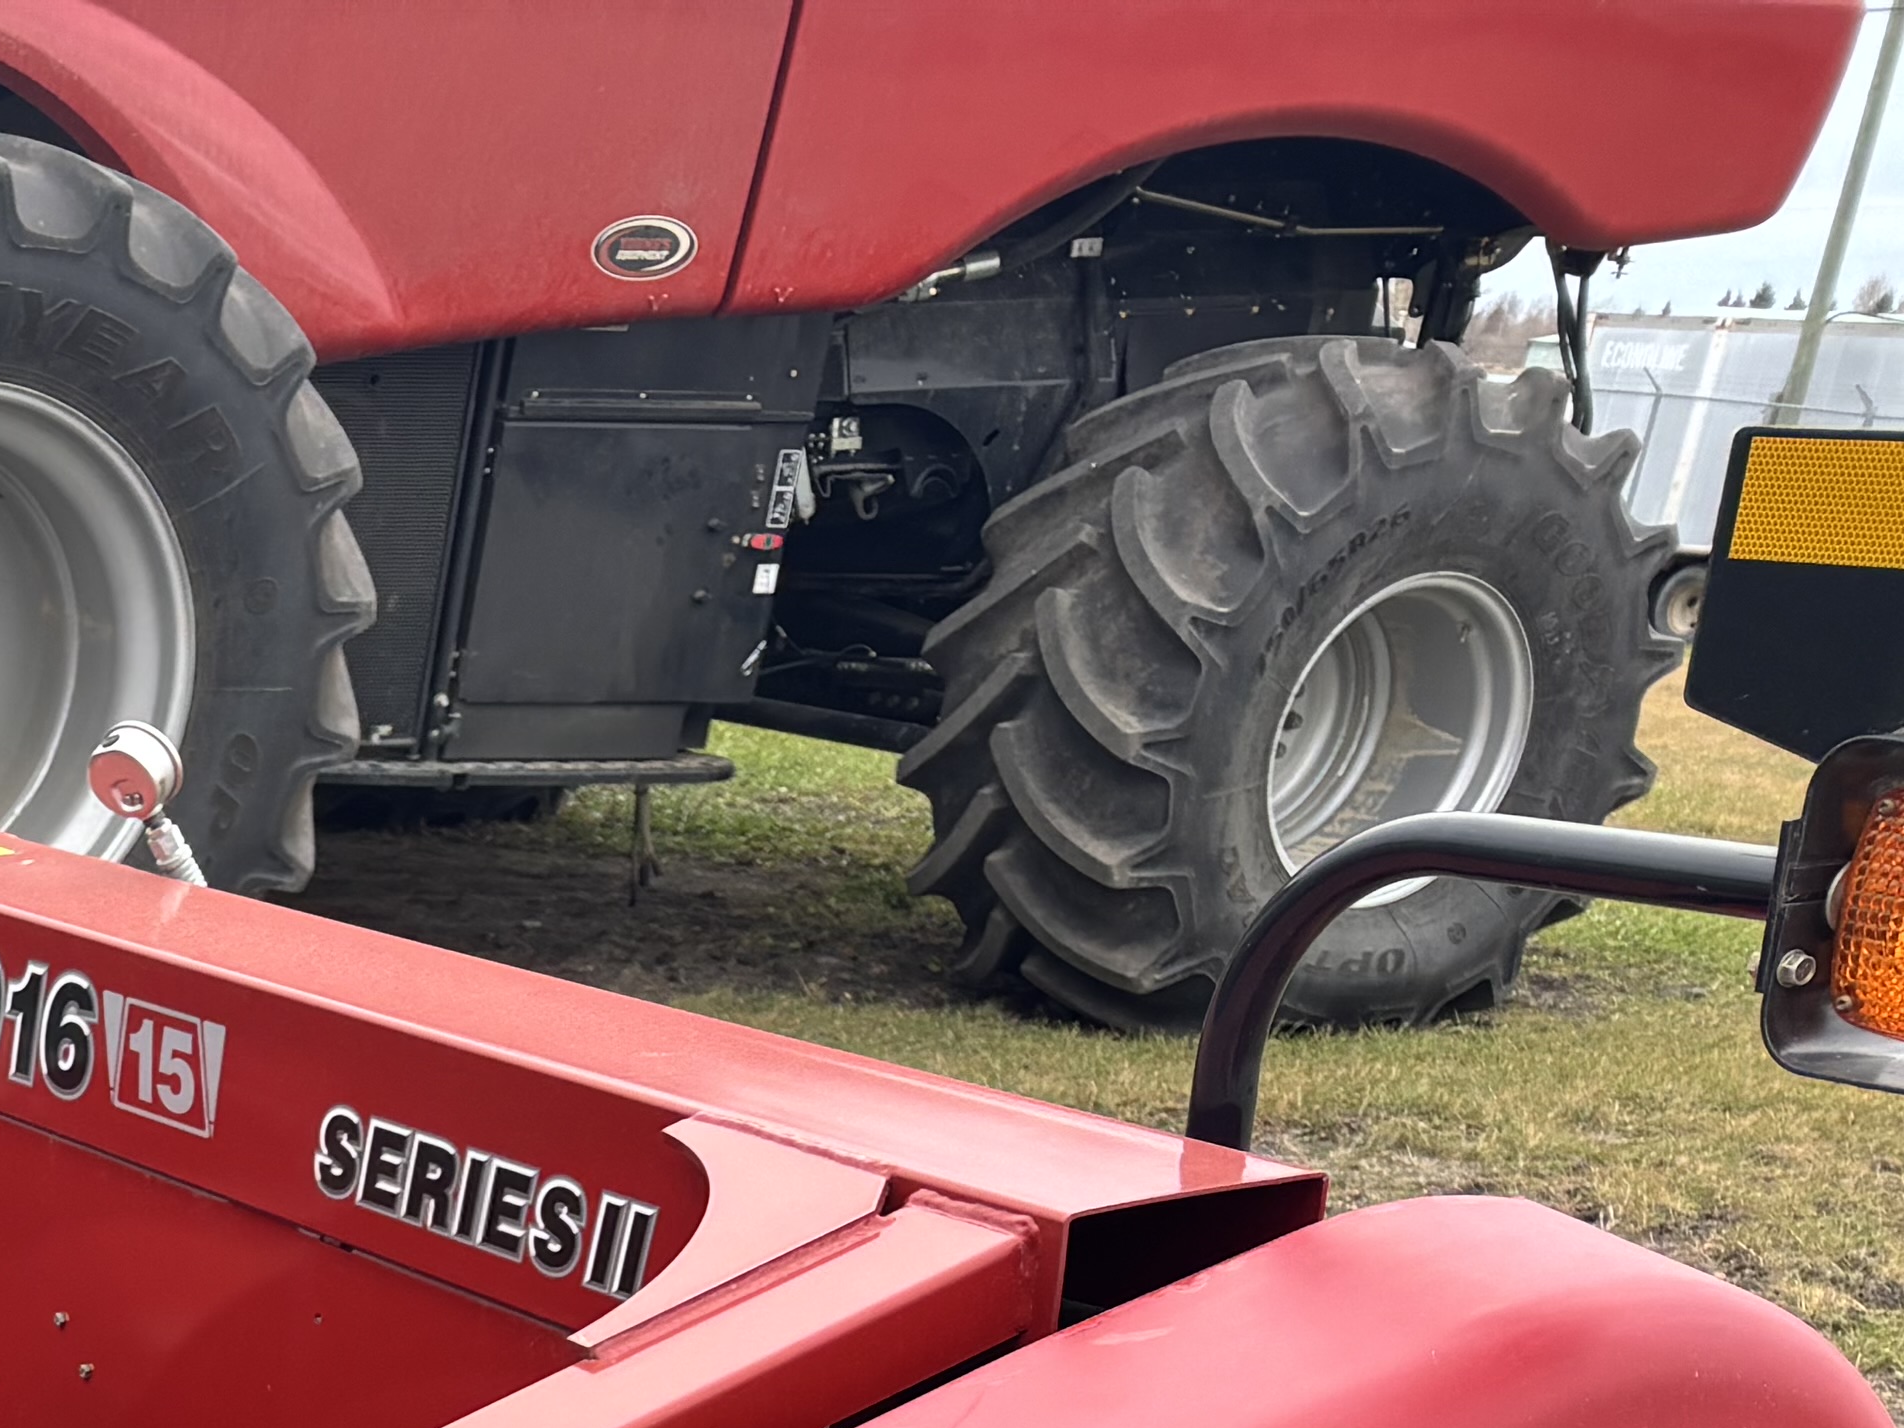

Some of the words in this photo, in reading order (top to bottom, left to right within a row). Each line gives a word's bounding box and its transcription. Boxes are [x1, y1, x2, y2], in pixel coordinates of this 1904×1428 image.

[128, 1017, 196, 1115] 15
[313, 1103, 588, 1279] SERIES
[582, 1189, 661, 1301] II
